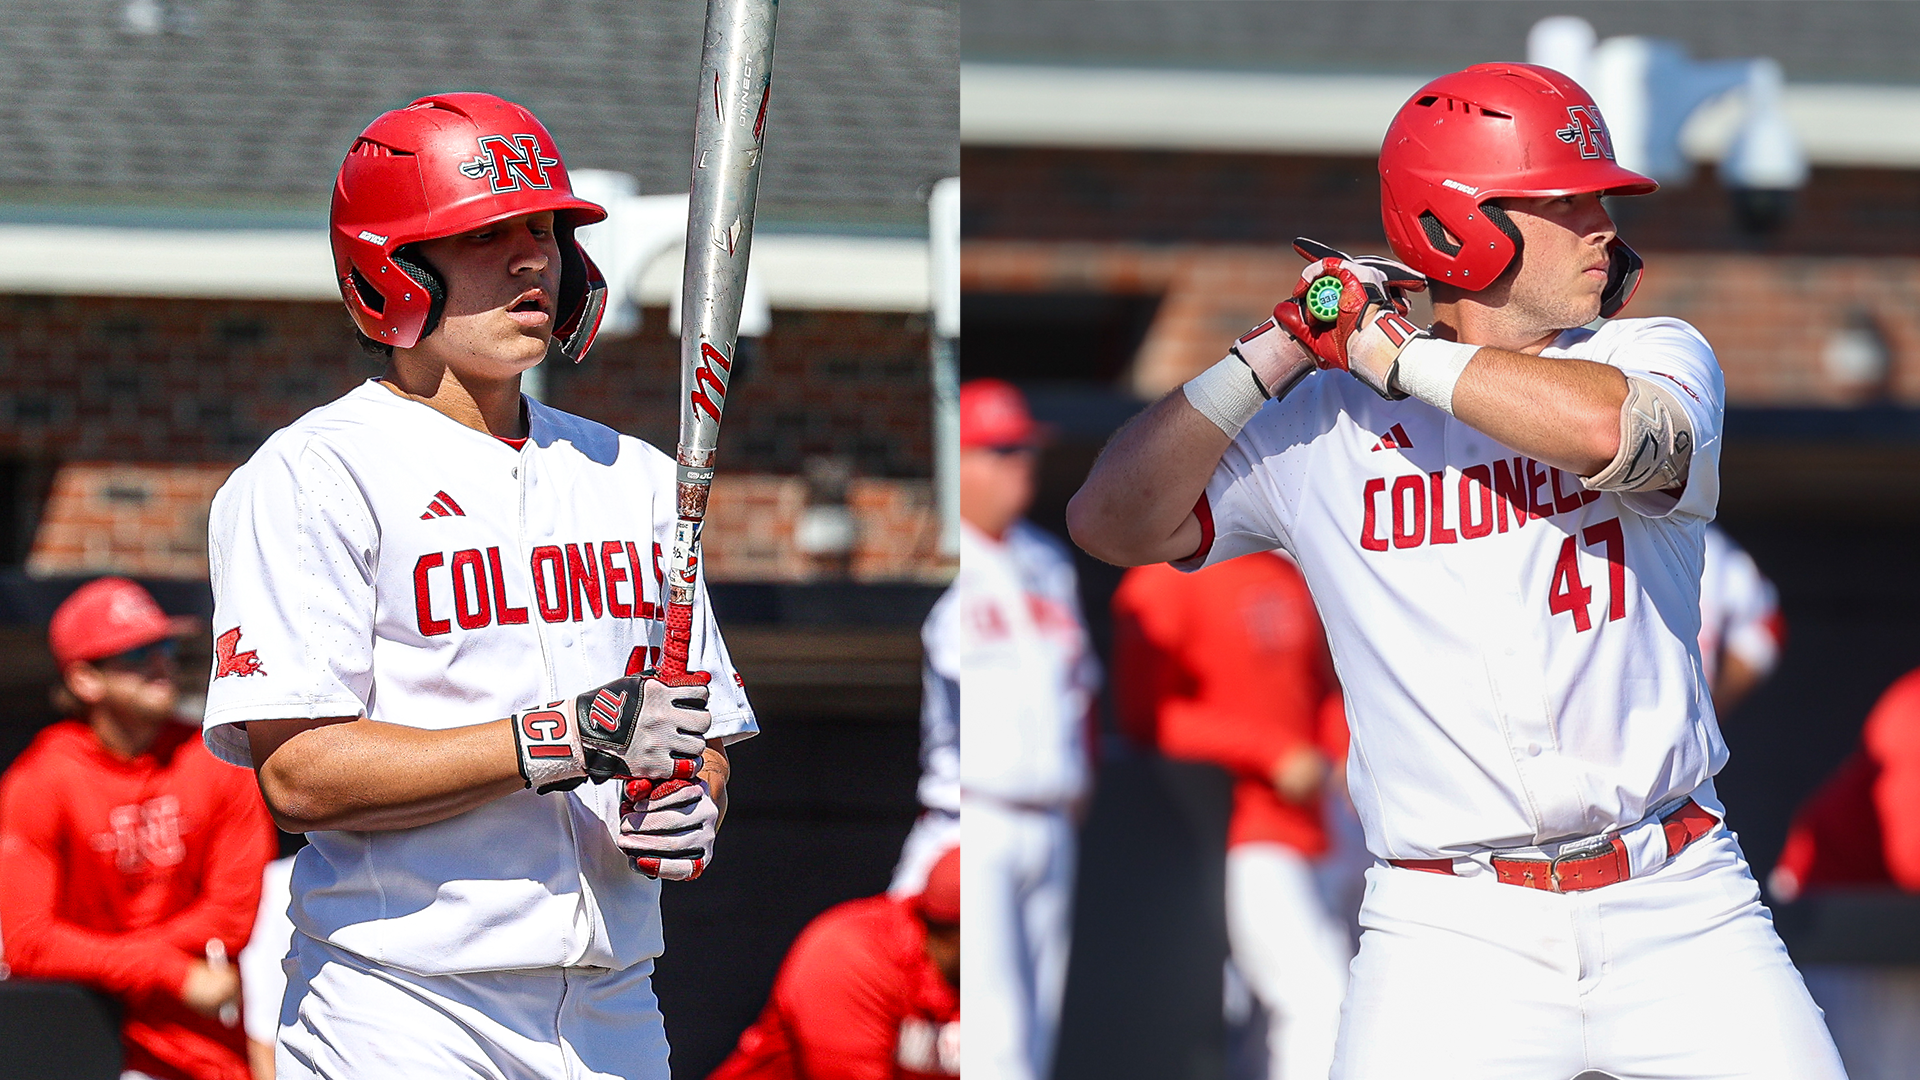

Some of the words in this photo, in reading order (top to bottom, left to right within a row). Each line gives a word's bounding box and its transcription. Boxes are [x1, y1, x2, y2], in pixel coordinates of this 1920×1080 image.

[1566, 105, 1615, 160] N
[477, 133, 553, 195] N
[1441, 178, 1479, 196] marucci
[1360, 456, 1601, 552] COLONEL
[1548, 516, 1626, 633] 47
[521, 699, 574, 760] CI
